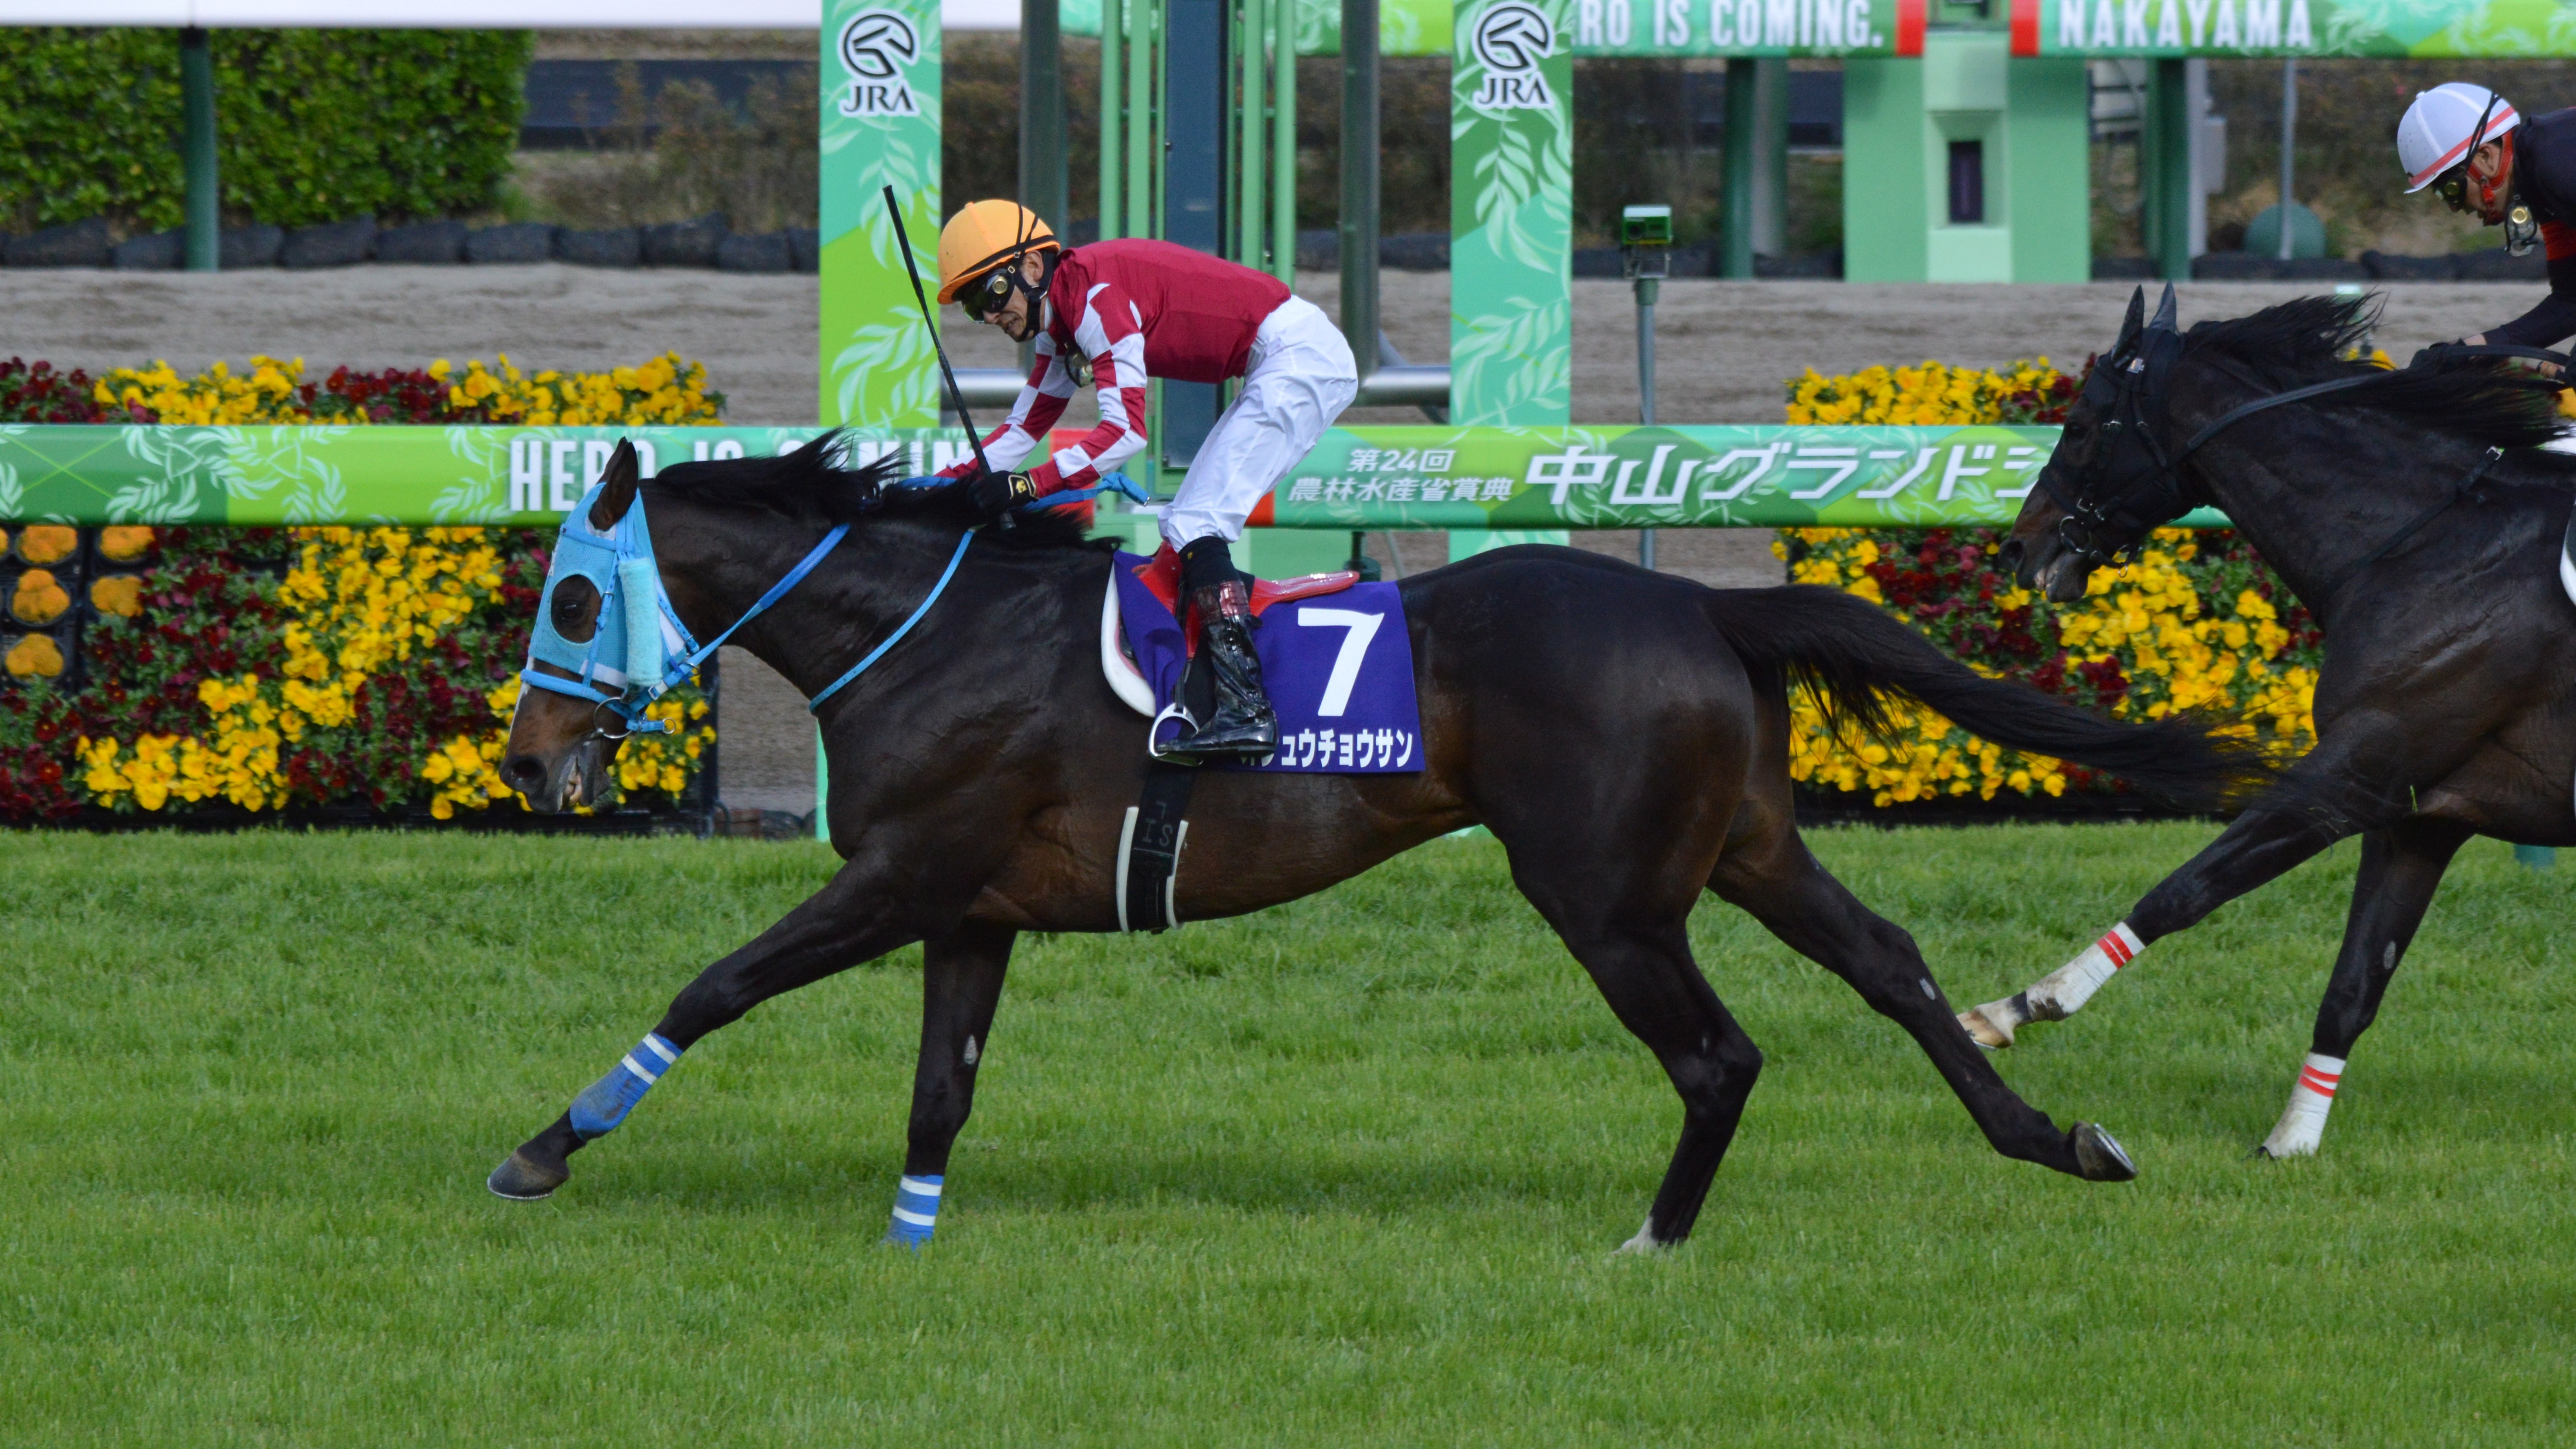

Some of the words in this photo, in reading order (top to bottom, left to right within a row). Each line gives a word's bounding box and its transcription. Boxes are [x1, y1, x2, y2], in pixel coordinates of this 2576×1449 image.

[1654, 0, 1690, 46] IS
[1711, 0, 1883, 47] COMING.
[2060, 0, 2312, 47] NAKAYAMA
[844, 86, 914, 112] JRA
[1478, 78, 1548, 104] JRA
[1348, 448, 1456, 473] 第24回
[1288, 477, 1515, 502] 農林水産省賞典
[1297, 608, 1385, 716] 7
[1240, 728, 1413, 768] ュウチョウサン
